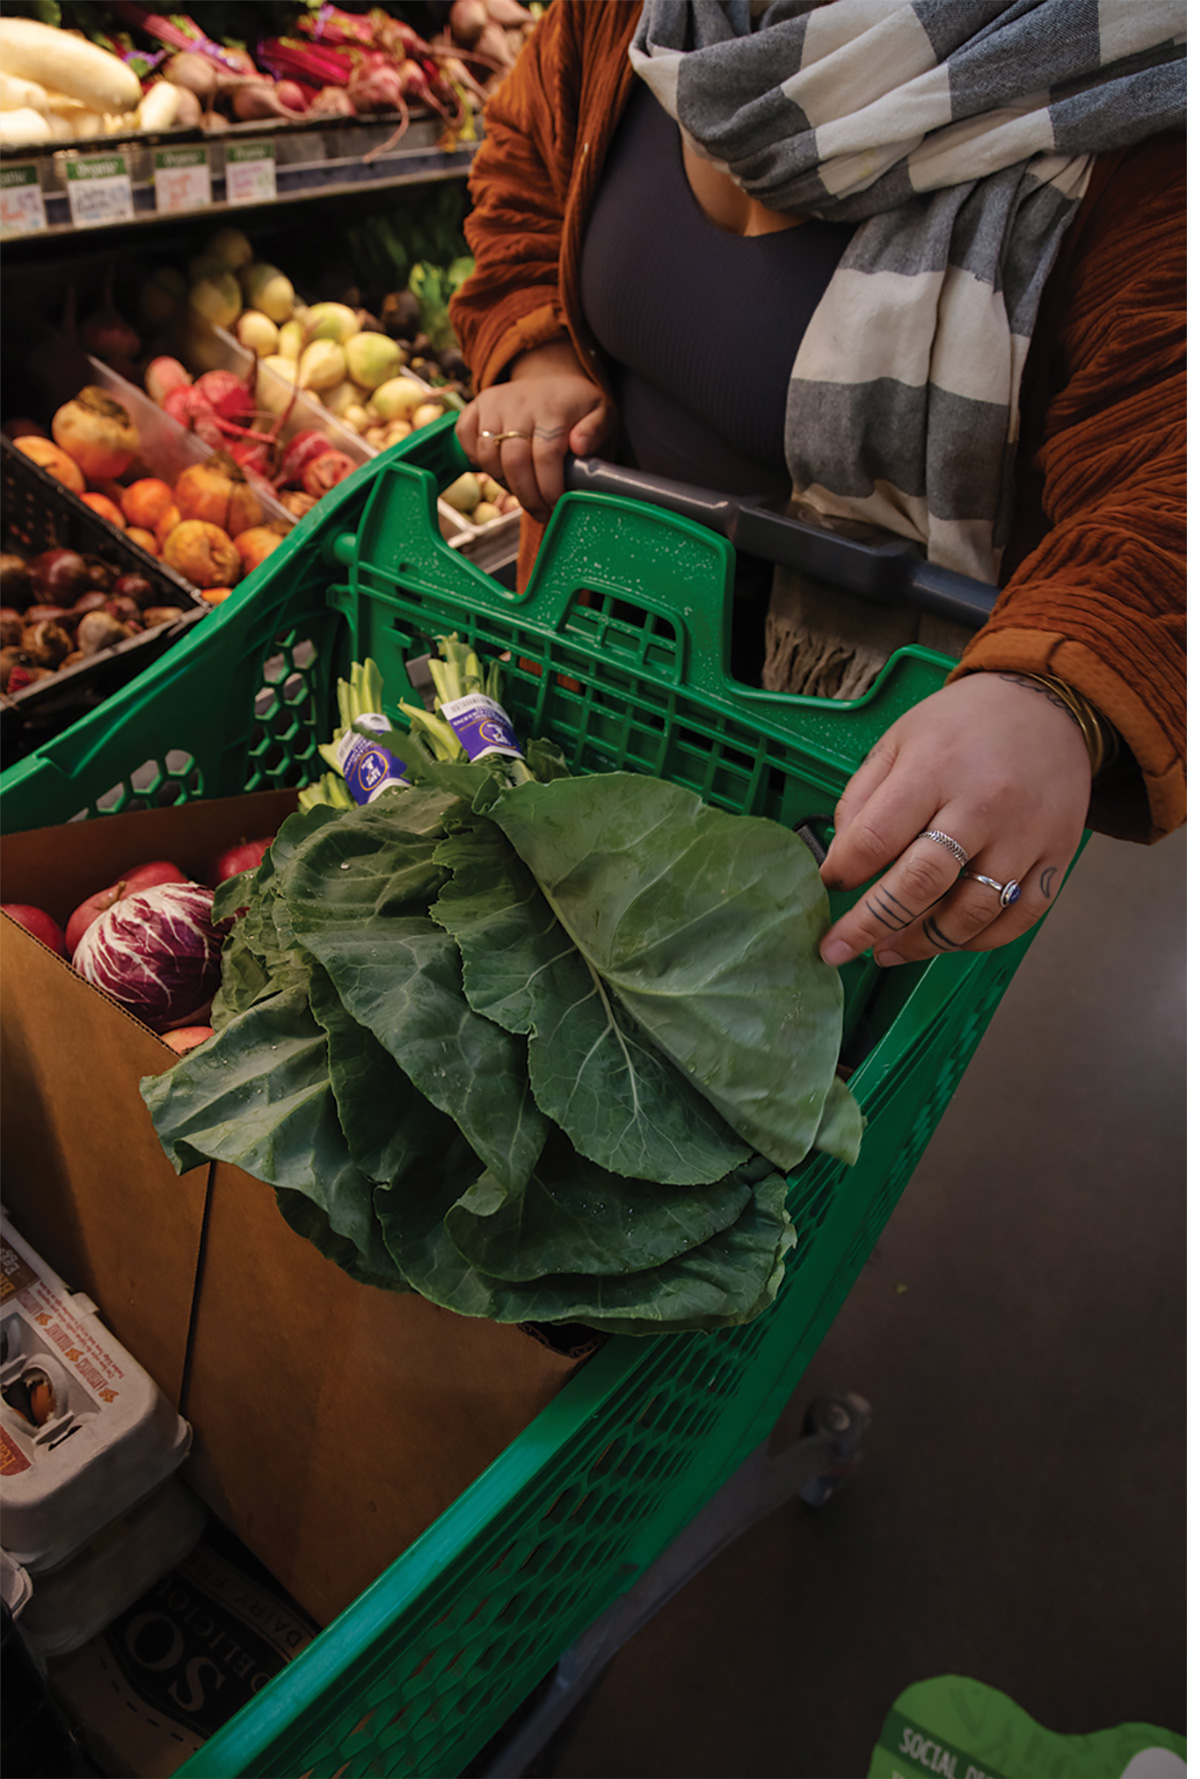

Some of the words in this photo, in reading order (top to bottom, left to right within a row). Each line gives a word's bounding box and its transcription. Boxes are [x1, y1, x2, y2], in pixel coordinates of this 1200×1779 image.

[184, 1553, 231, 1591] FRE
[235, 1591, 304, 1649] DAIRY
[125, 1611, 226, 1713] SO
[899, 1727, 958, 1779] SOCIAL
